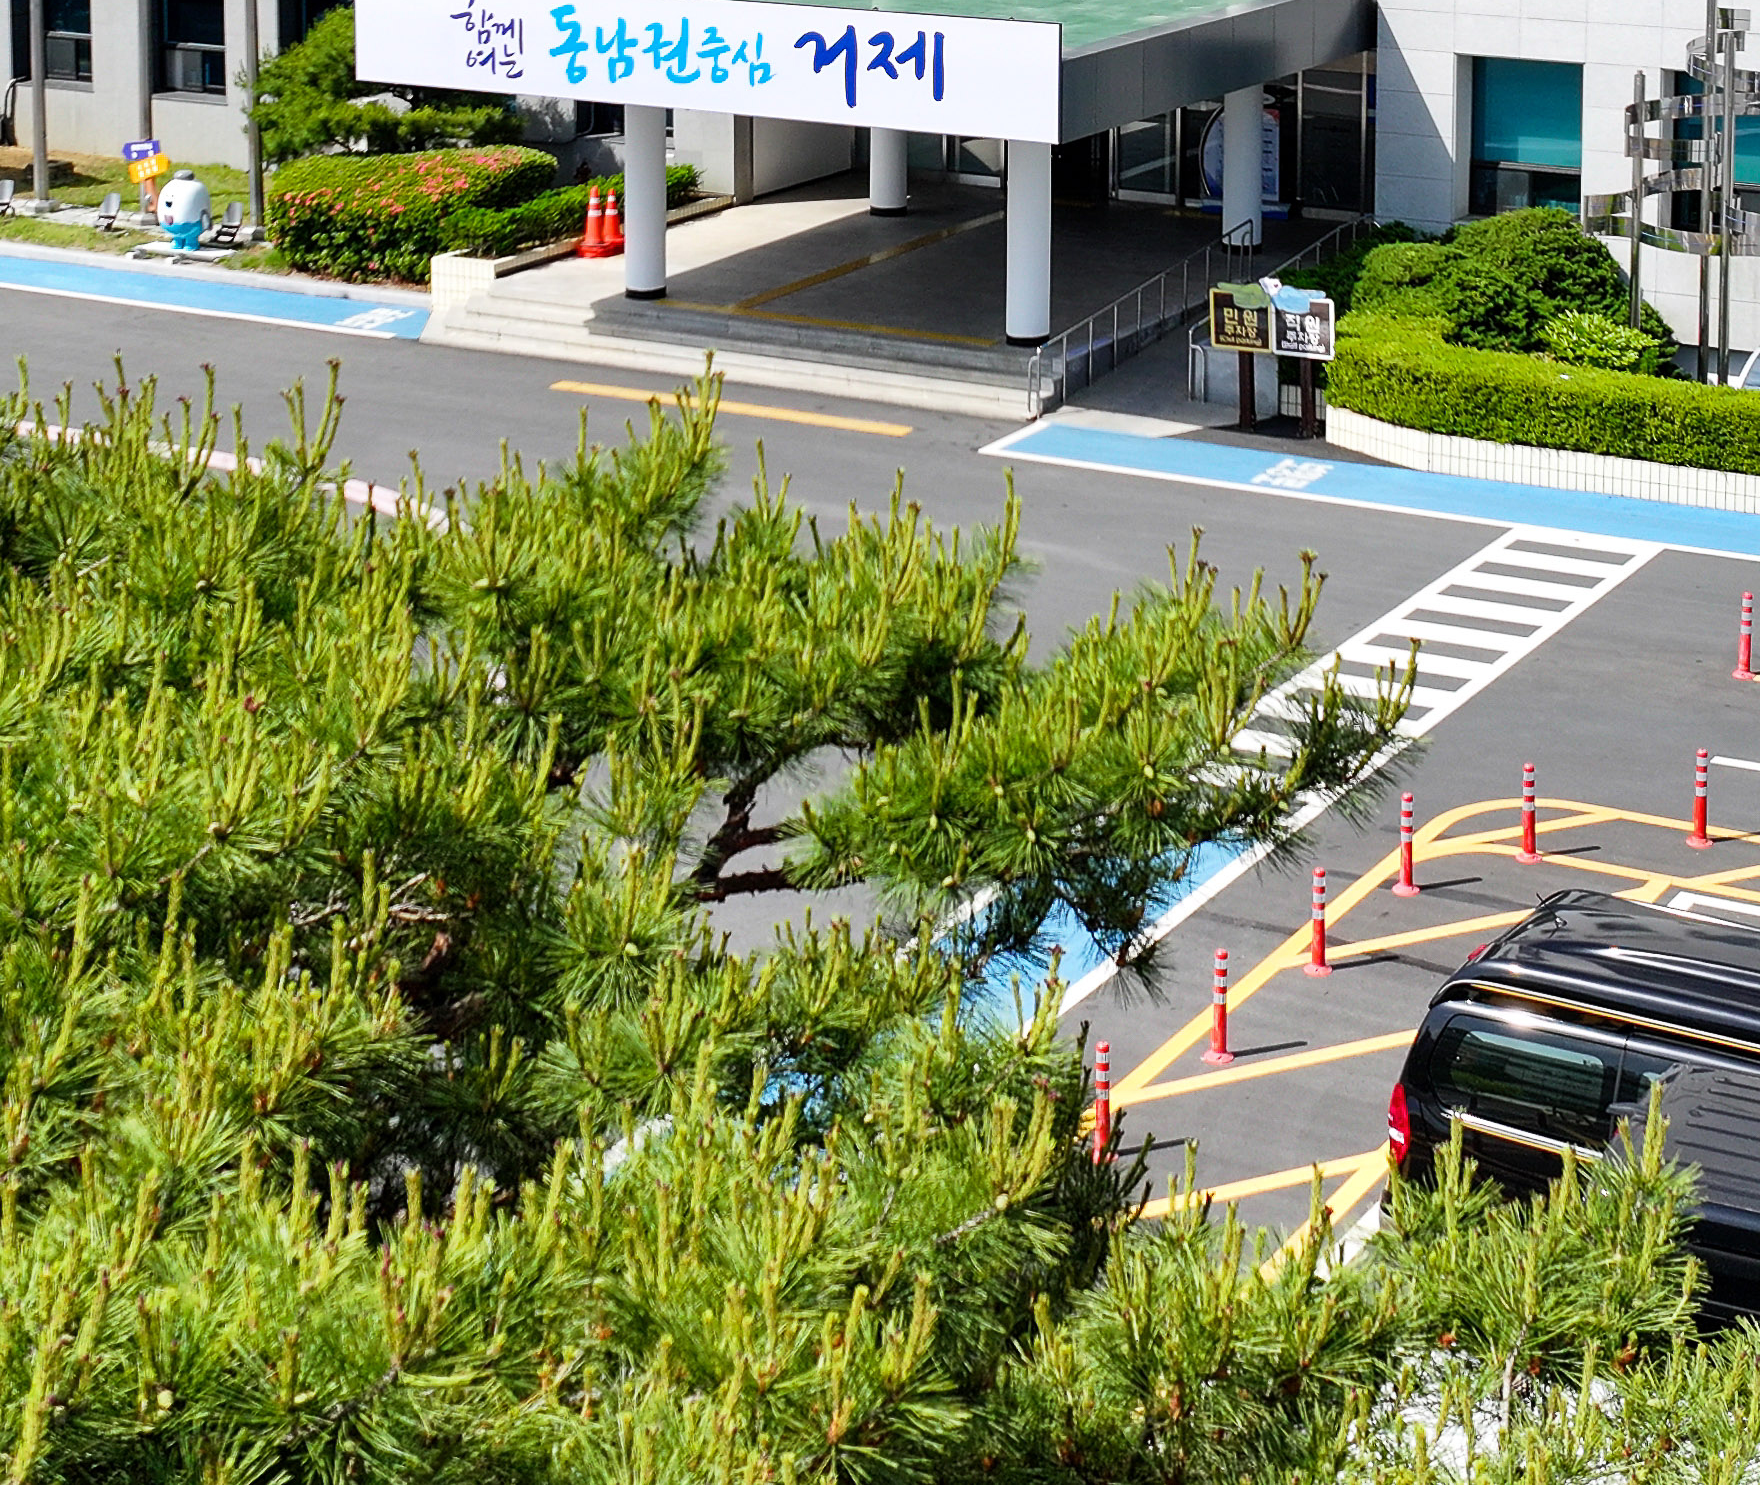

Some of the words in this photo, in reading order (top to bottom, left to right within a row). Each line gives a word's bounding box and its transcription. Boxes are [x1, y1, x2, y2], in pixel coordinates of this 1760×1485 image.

[466, 45, 524, 79] 여는
[793, 25, 945, 108] 거제
[1223, 307, 1258, 327] 민원
[1285, 313, 1321, 334] 직원
